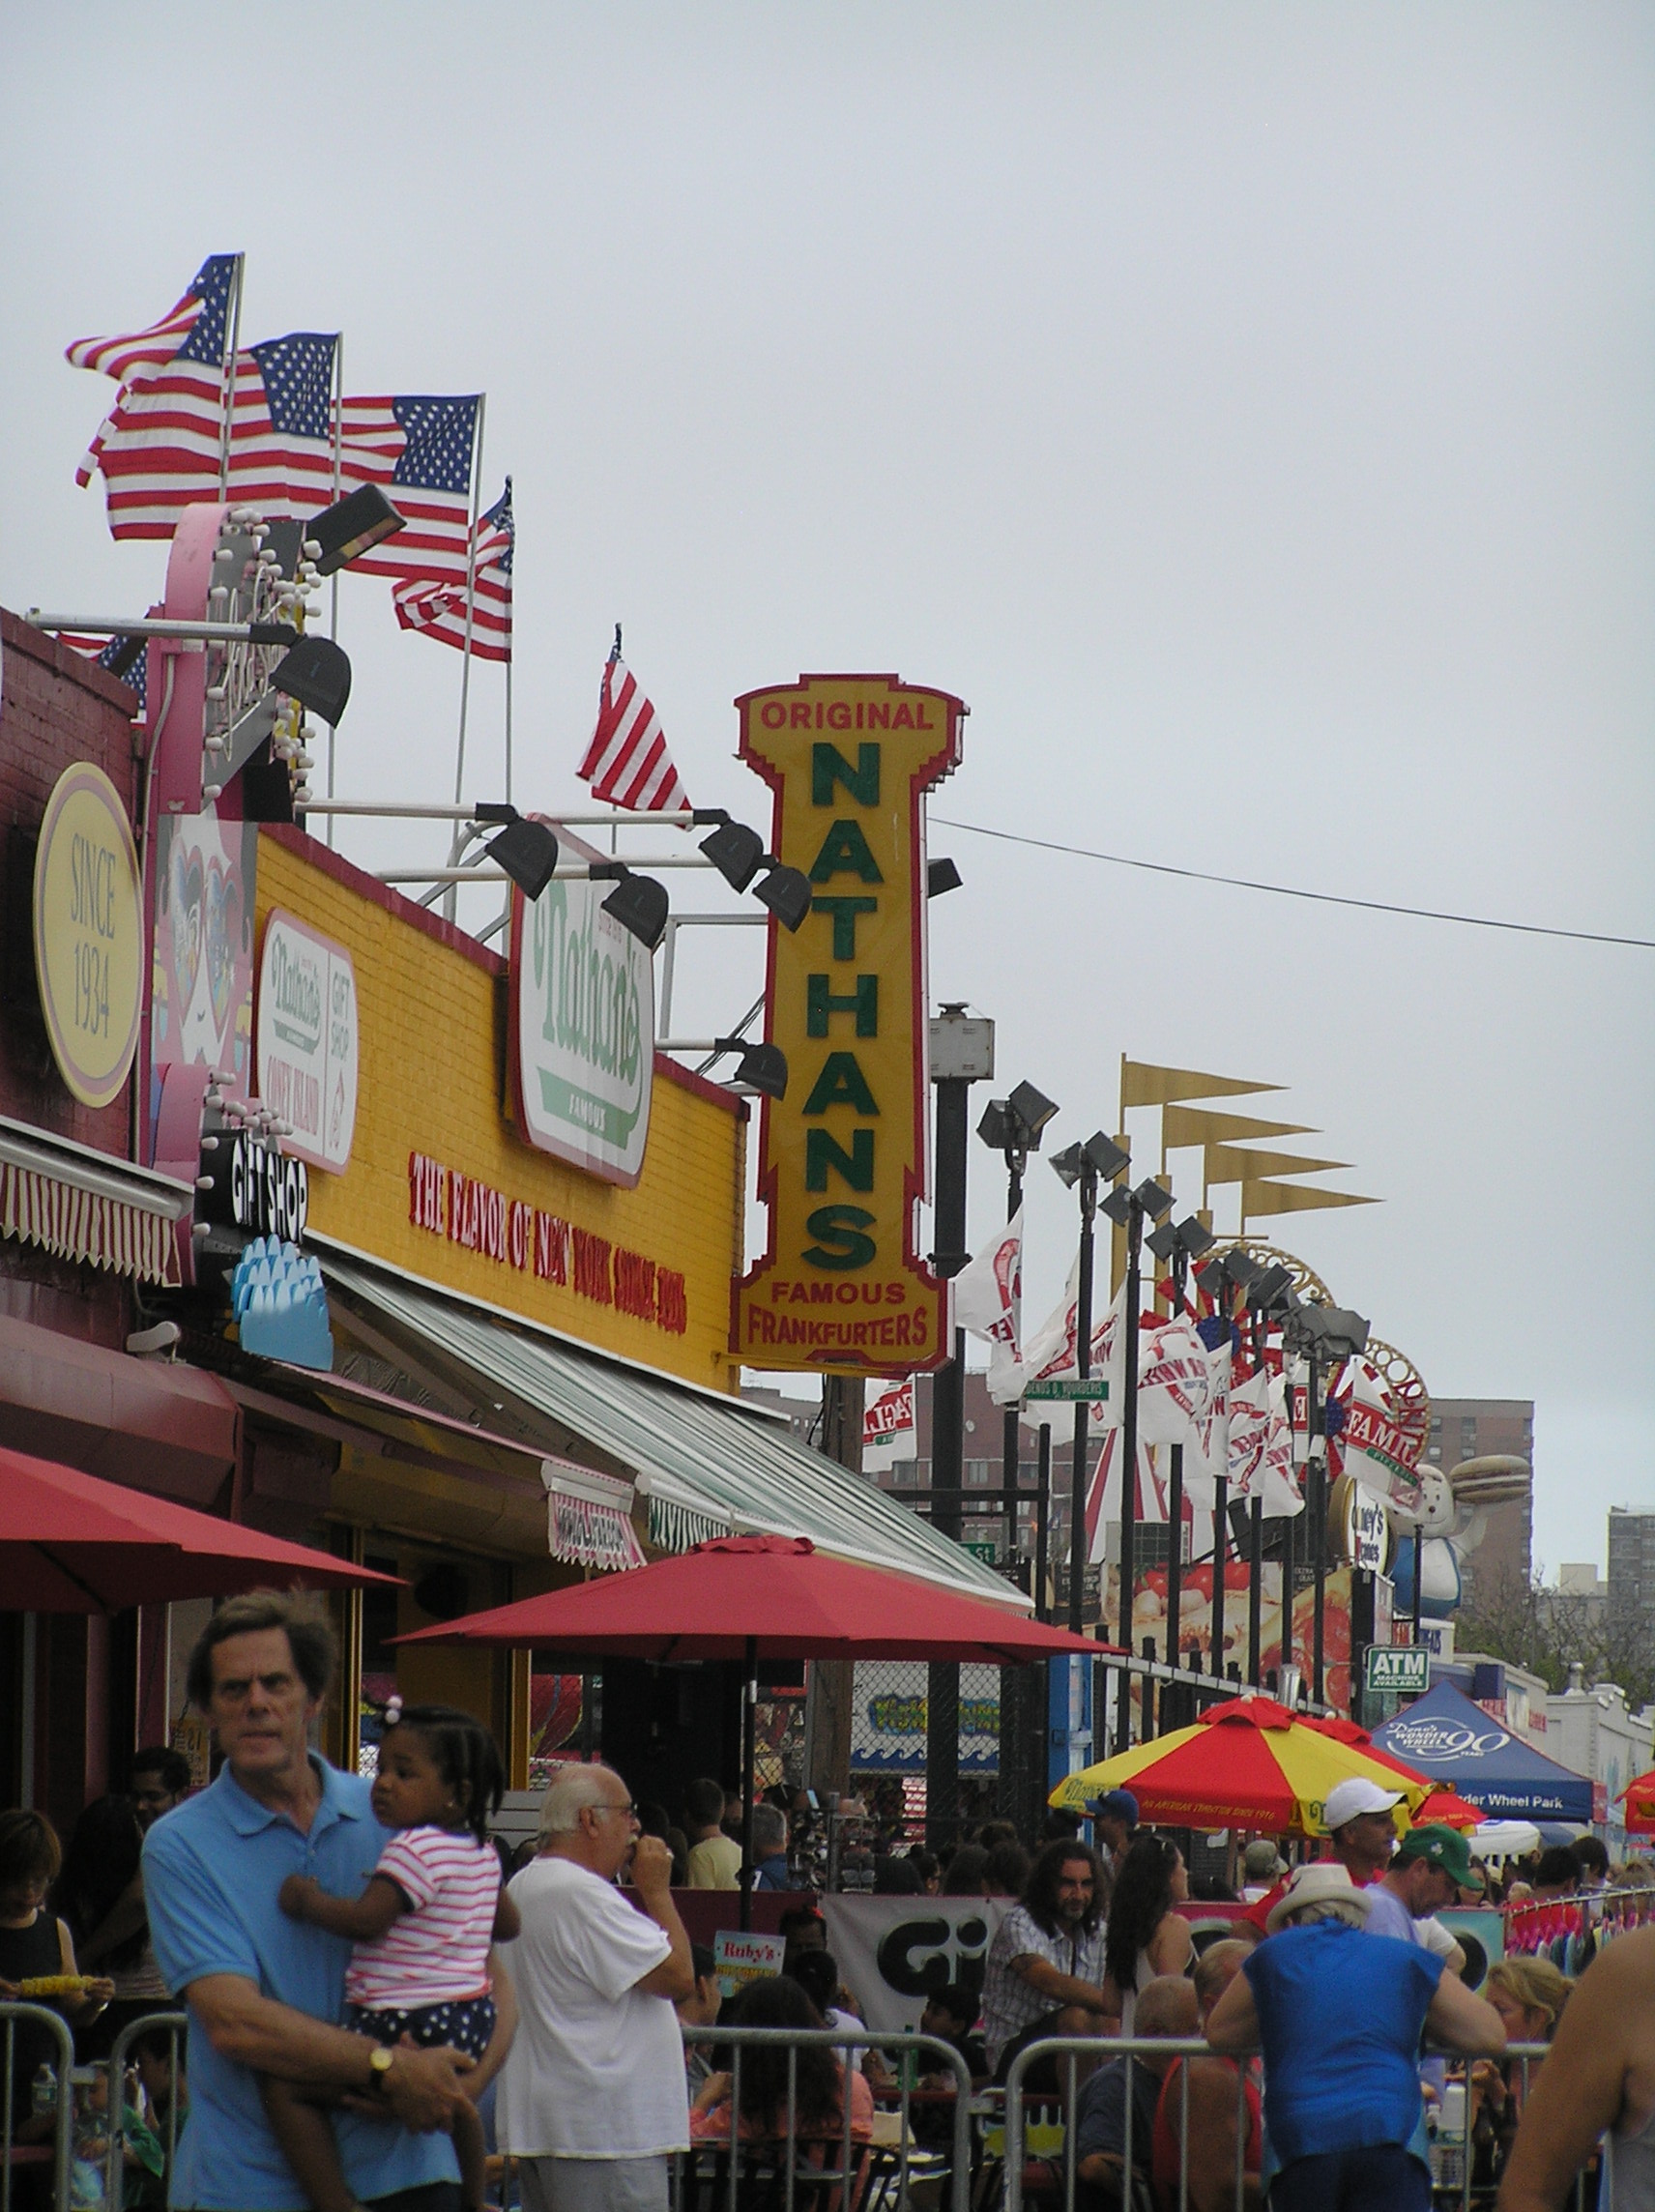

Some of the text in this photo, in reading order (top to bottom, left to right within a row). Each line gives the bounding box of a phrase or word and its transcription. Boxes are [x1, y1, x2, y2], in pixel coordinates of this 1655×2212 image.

[760, 701, 934, 731] ORIGINAL
[71, 832, 118, 940] SINCE
[73, 942, 110, 1039] 1934
[332, 971, 351, 1020] GIFT
[800, 742, 885, 1271] NATHANS
[330, 1020, 350, 1062] SHOP
[268, 1151, 307, 1246] SHOP
[408, 1150, 445, 1236] THE
[447, 1169, 507, 1263] FLAVOR
[508, 1199, 532, 1271] OF
[770, 1281, 907, 1305] FAMOUS
[746, 1303, 928, 1349] FRANKFURTERS
[1373, 1652, 1425, 1674] ATM
[1386, 1722, 1438, 1733] Deno's
[1395, 1731, 1449, 1740] WONDER
[1415, 1730, 1511, 1757] 90
[1487, 1794, 1529, 1808] Wheel
[1532, 1795, 1564, 1810] Park
[724, 1941, 774, 1964] Ruby's
